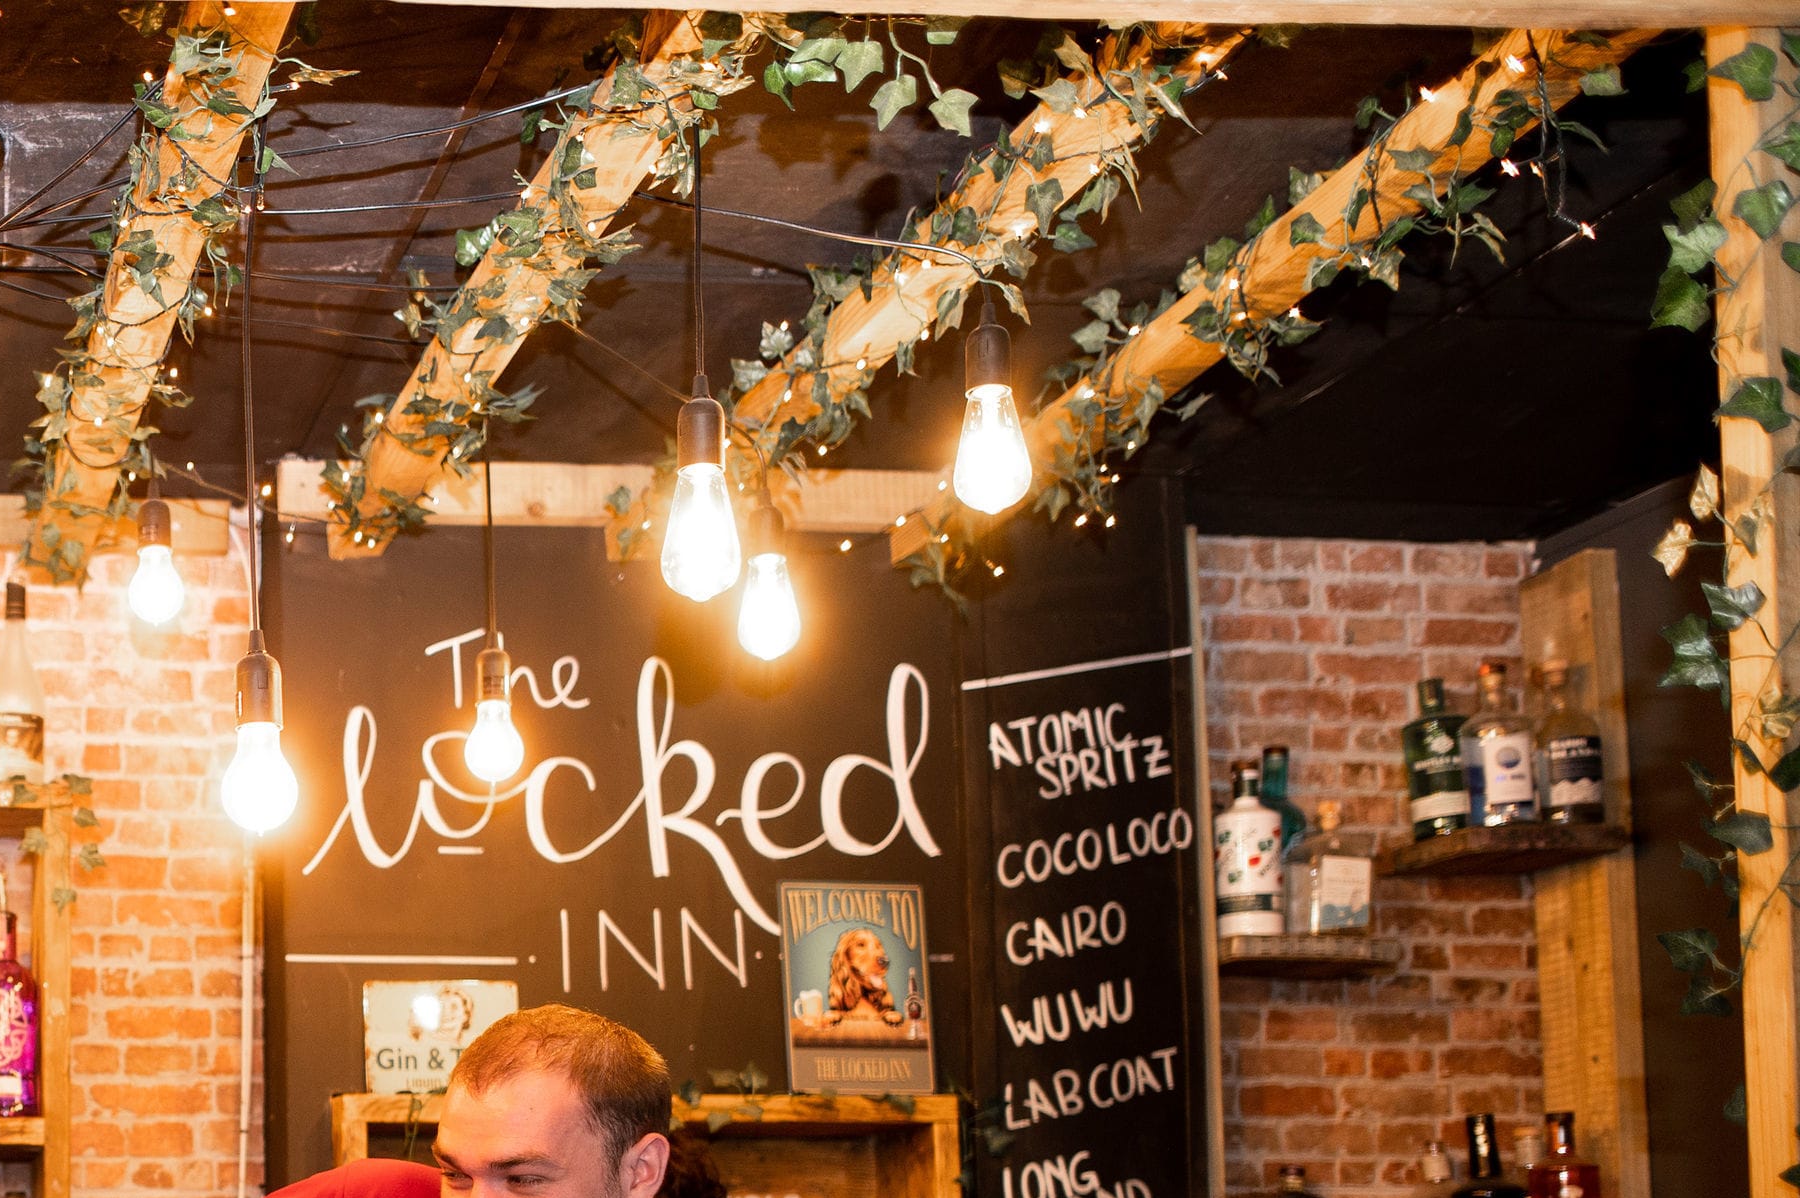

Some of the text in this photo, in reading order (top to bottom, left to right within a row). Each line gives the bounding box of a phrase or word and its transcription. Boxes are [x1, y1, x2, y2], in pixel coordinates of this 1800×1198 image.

[425, 628, 590, 709] The
[989, 703, 1126, 770] ATOMIC
[1035, 733, 1172, 799] SPRITZ
[561, 907, 747, 991] INN
[787, 889, 917, 950] WELCOME TO
[1005, 901, 1127, 966] CAIRO
[376, 1048, 417, 1069] Gin
[428, 1048, 444, 1069] &
[816, 1056, 913, 1082] THE LOCKED INN
